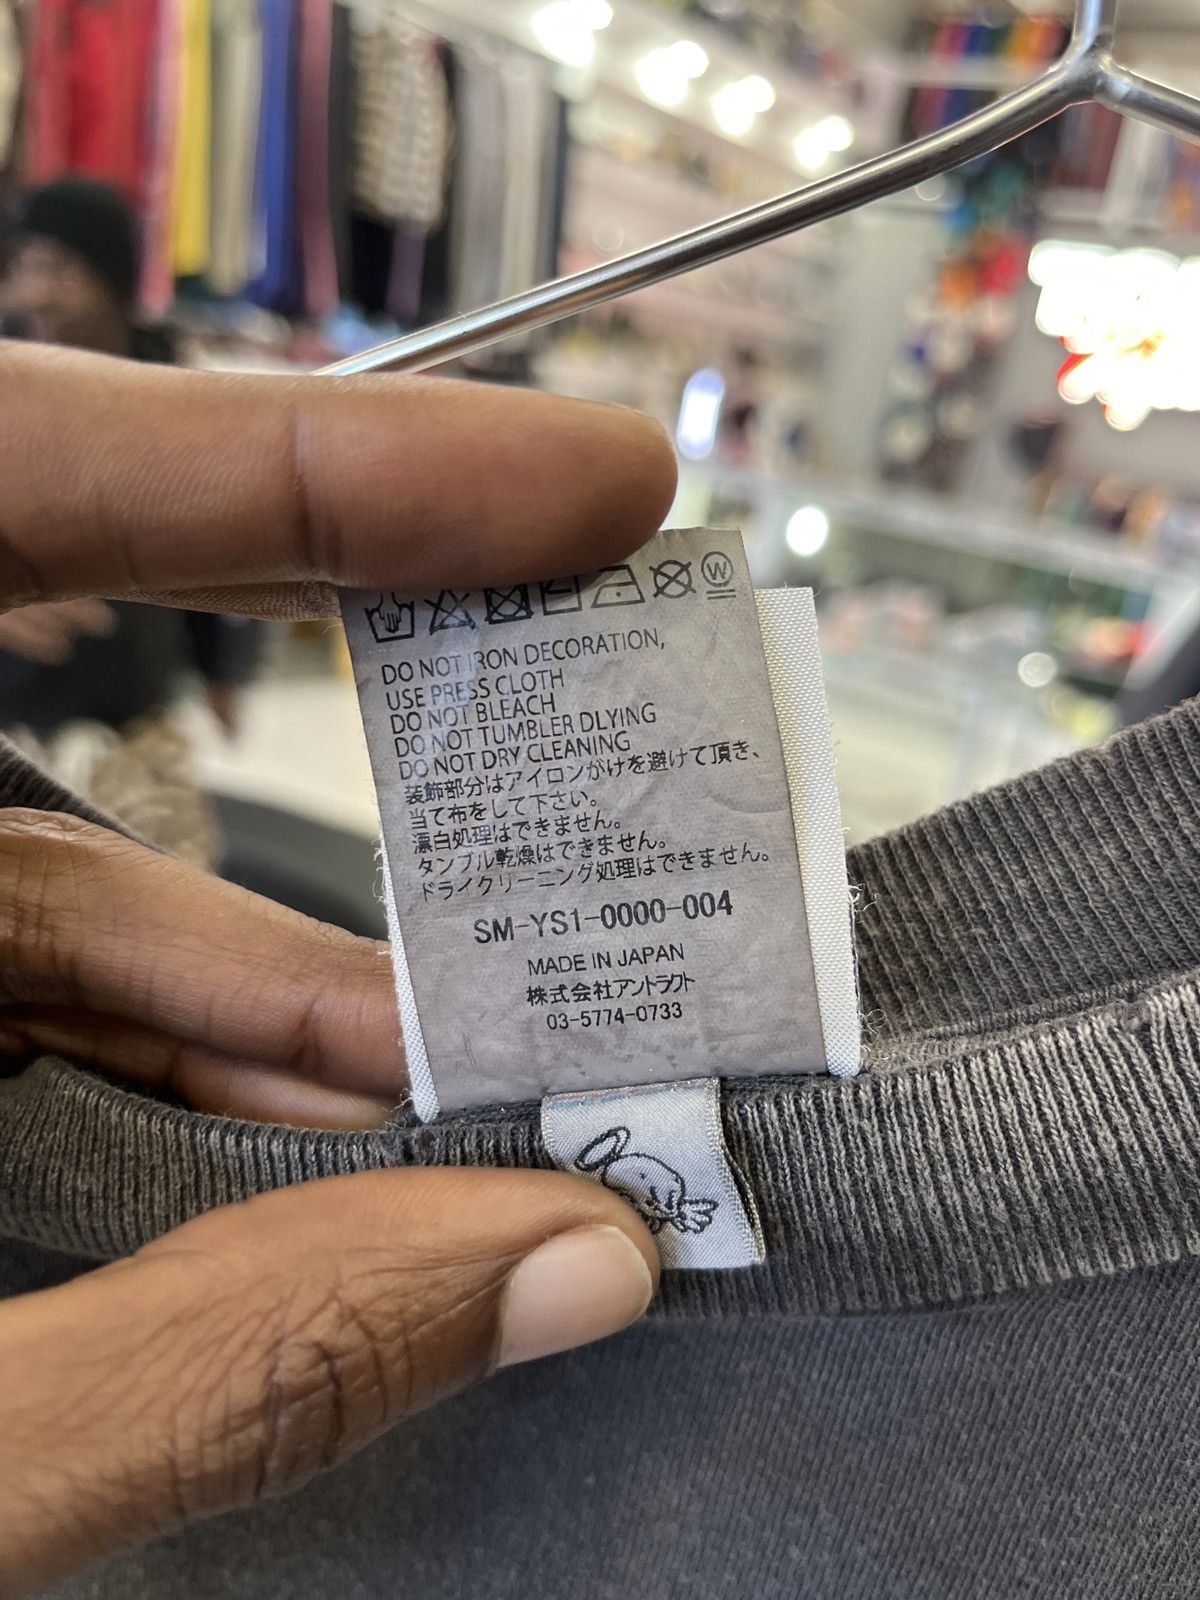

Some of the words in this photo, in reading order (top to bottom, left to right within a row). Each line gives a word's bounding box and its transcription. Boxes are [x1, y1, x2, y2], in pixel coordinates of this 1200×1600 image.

[381, 662, 414, 685] DO
[419, 655, 461, 678] NOT
[468, 648, 518, 671] IRON
[524, 628, 665, 665] DECORATION,
[386, 687, 426, 711] USE
[430, 677, 490, 705] PRESS
[496, 668, 564, 695] CLOTH
[390, 711, 422, 734] DO
[427, 704, 469, 729] NOT
[476, 693, 556, 723] BLEACH
[394, 734, 426, 757] DO
[431, 728, 473, 753] NOT
[478, 714, 574, 746] TUMBLER
[580, 703, 657, 733] DLYING
[399, 759, 429, 780] DO
[434, 752, 476, 776] NOT
[482, 746, 520, 770] DRY
[527, 730, 630, 763] CLEANING
[404, 740, 759, 805] 装飾部分はアイロンがけを避けて頂き、
[410, 790, 597, 830] 当て布をして下さい。
[412, 810, 621, 854] 漂白処理はできません。
[418, 830, 666, 877] タンブル乾燥はできません。
[422, 842, 769, 902] ドライクリーニング処理はできません。
[473, 890, 733, 944] SM-YS1-0000-004
[527, 954, 587, 975] MADE
[592, 951, 612, 969] IN
[618, 943, 685, 967] JAPAN
[526, 971, 695, 1007] 株式会社アントラクト
[547, 1002, 683, 1030] 03-5774-0733
